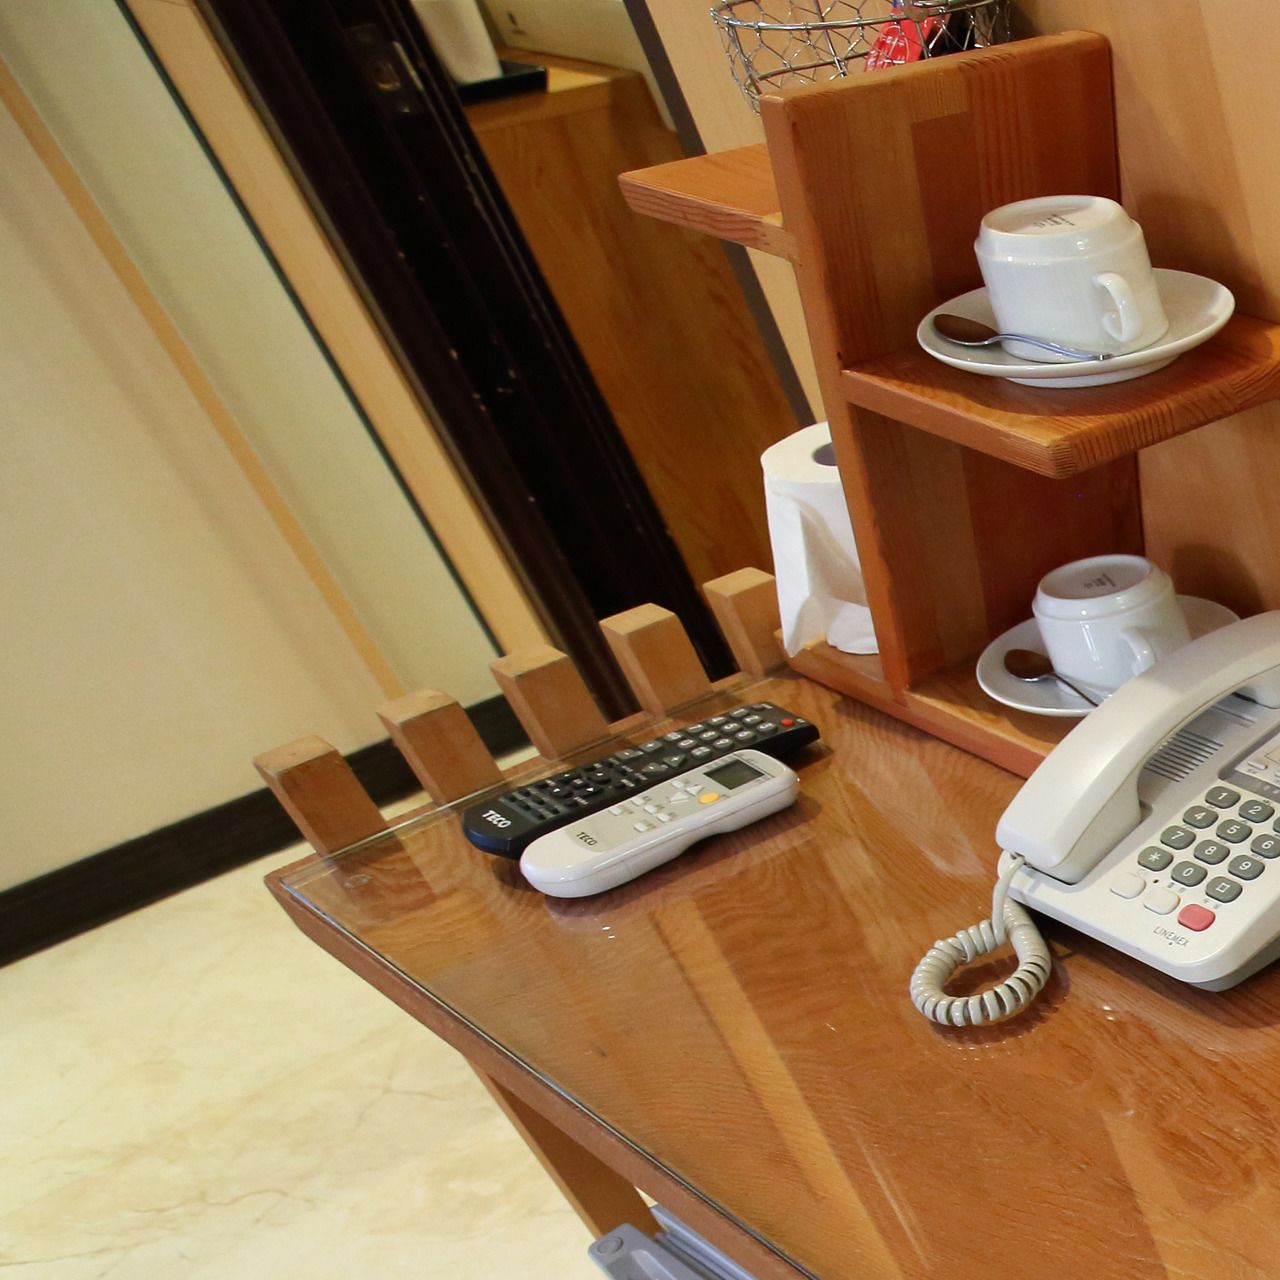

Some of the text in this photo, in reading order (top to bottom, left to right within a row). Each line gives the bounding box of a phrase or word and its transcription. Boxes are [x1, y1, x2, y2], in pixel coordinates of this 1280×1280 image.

[482, 810, 512, 828] TECO
[576, 832, 598, 846] TECO
[1153, 926, 1190, 947] LINEMEX
